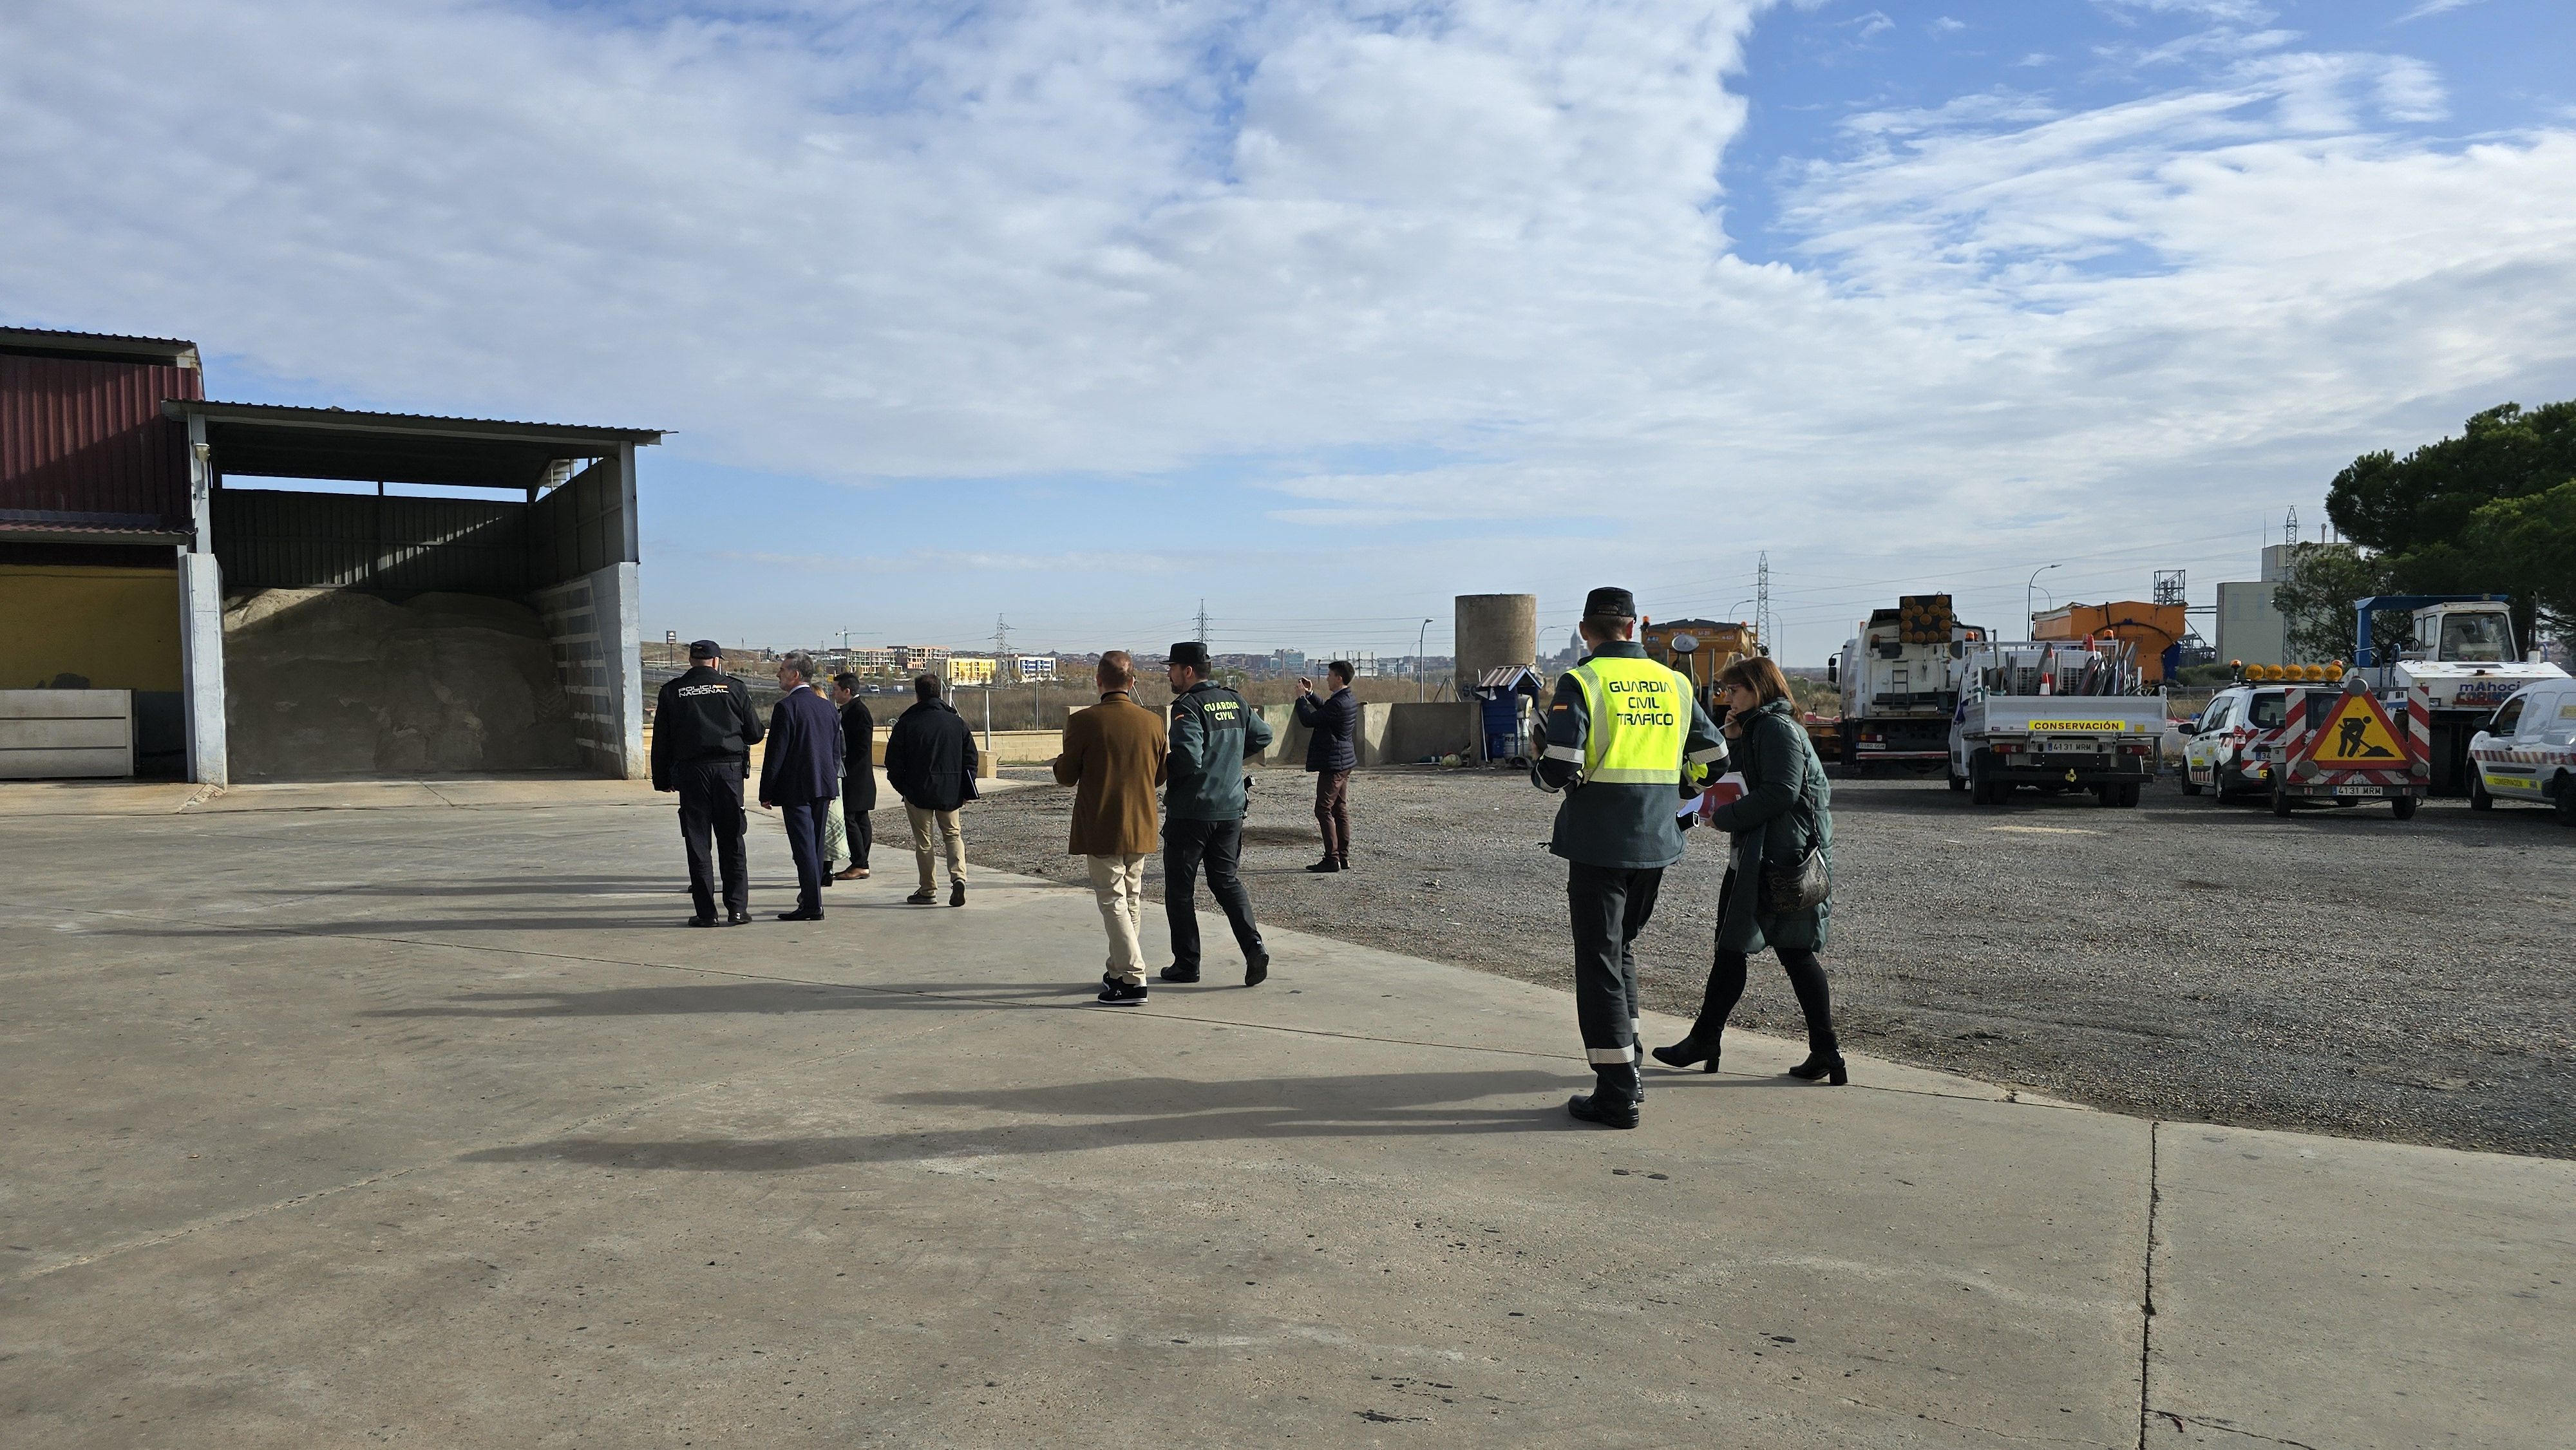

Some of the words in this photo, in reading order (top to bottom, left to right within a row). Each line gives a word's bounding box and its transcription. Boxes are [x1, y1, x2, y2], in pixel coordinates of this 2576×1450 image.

[678, 684, 717, 693] POLICIA
[1609, 681, 1672, 693] GUARDIA
[679, 688, 730, 697] NACIONAL
[1204, 701, 1240, 711] GUARDIA
[1628, 697, 1660, 708] CIVIL
[1215, 711, 1235, 720] CIVIL
[1616, 710, 1674, 726] TRÁFICO
[2034, 721, 2119, 730] CONSERVACIÓN
